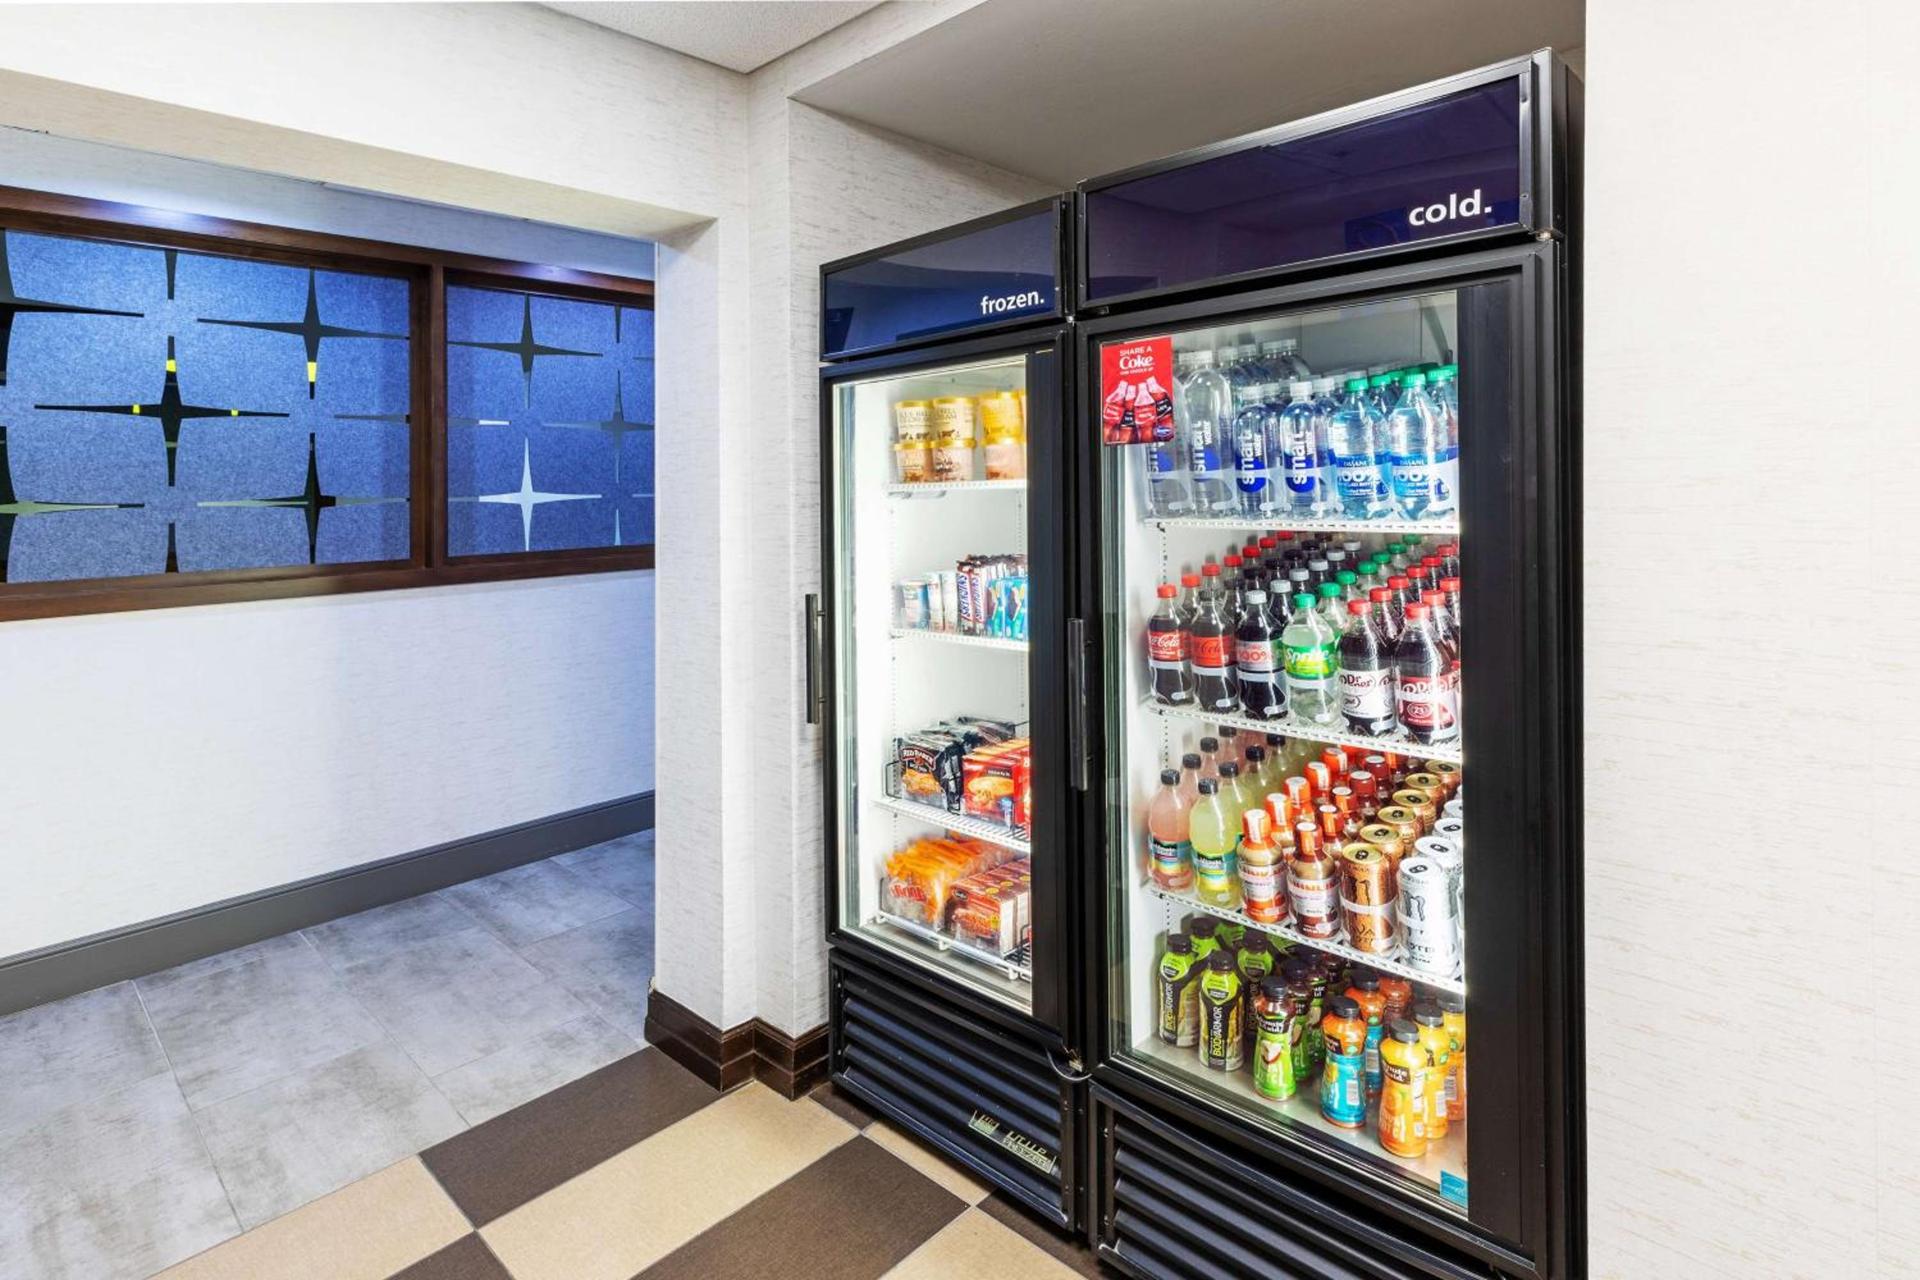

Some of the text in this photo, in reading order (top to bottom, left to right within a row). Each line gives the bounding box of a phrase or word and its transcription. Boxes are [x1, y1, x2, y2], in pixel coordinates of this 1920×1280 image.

[1408, 188, 1492, 226] cold.
[980, 291, 1045, 315] frozen.
[1119, 354, 1154, 370] Coke
[1240, 429, 1256, 486] smart
[1291, 432, 1308, 486] smart
